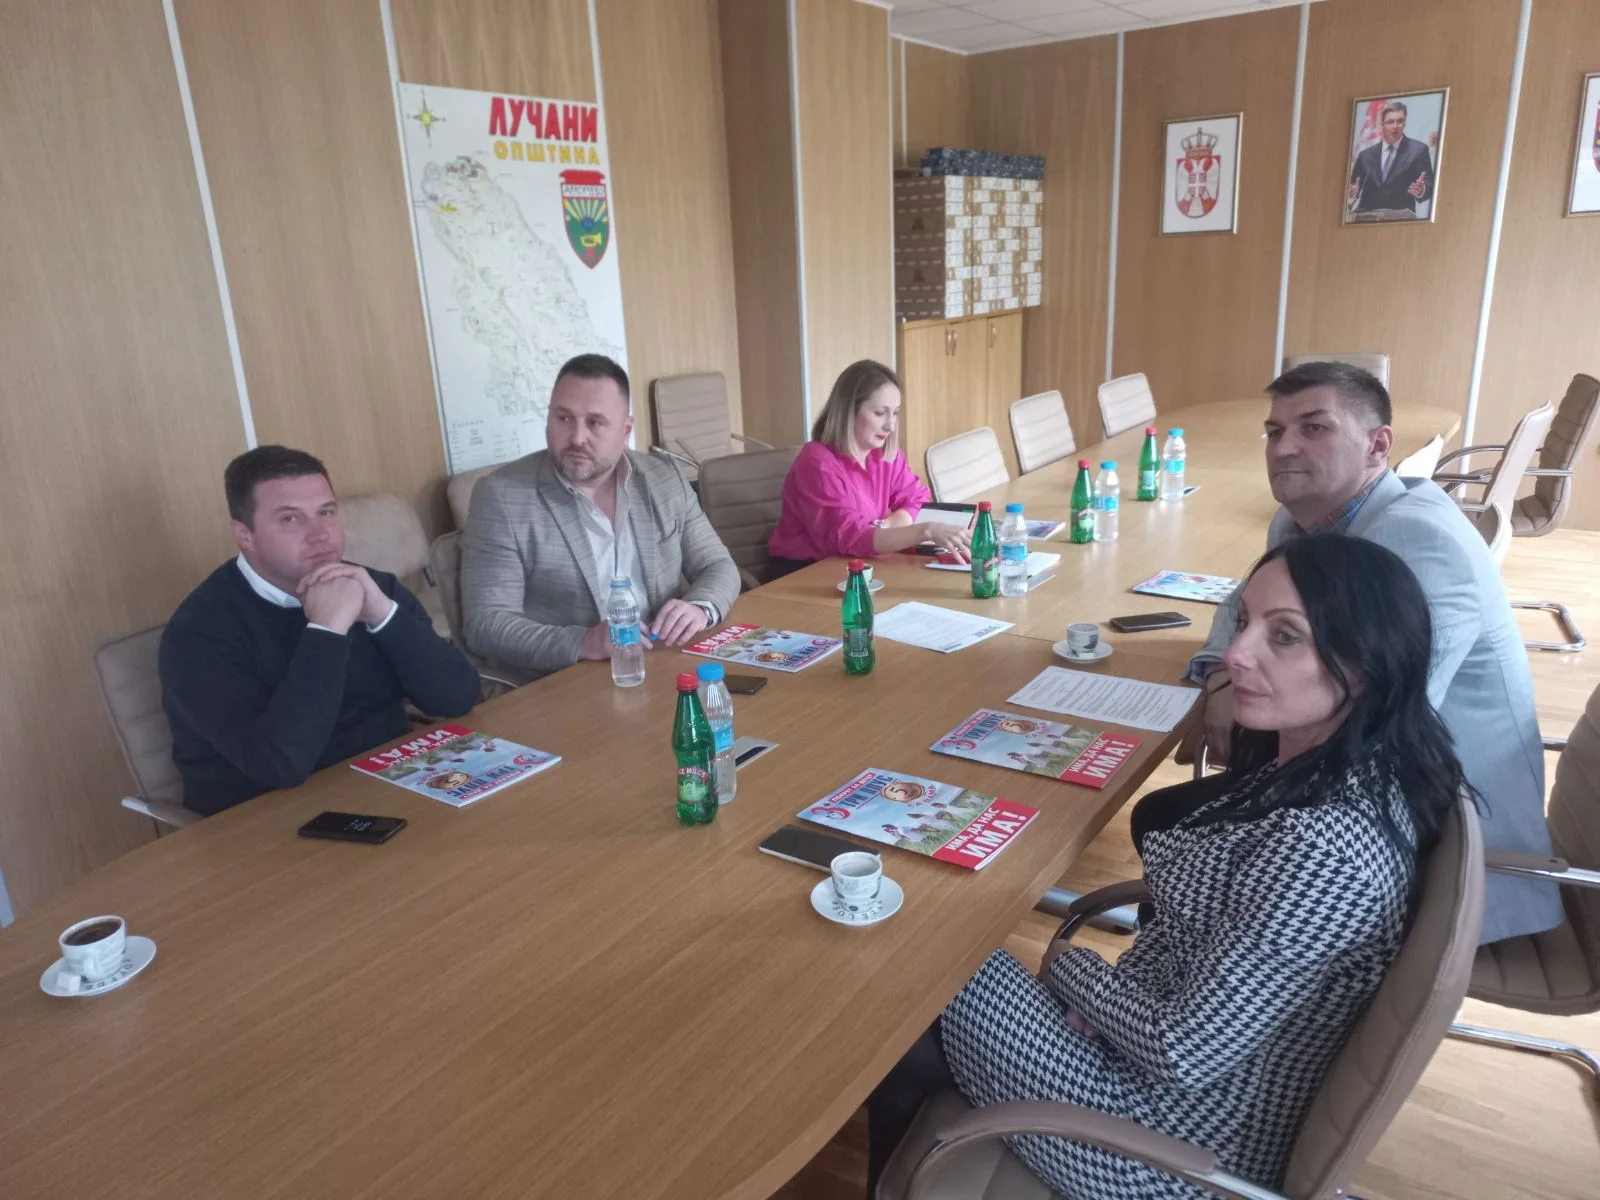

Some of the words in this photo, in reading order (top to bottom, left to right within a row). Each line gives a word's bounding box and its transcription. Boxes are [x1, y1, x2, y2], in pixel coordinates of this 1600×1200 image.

[489, 96, 598, 143] ЛУЧАНИ
[494, 140, 600, 165] ОПШТИНА
[369, 728, 453, 765] ИМА!
[1081, 740, 1135, 779] ИМА!
[945, 834, 974, 851] ИМА,
[967, 822, 985, 836] ДА
[977, 807, 1000, 824] НАС
[959, 811, 1028, 859] ИМА!
